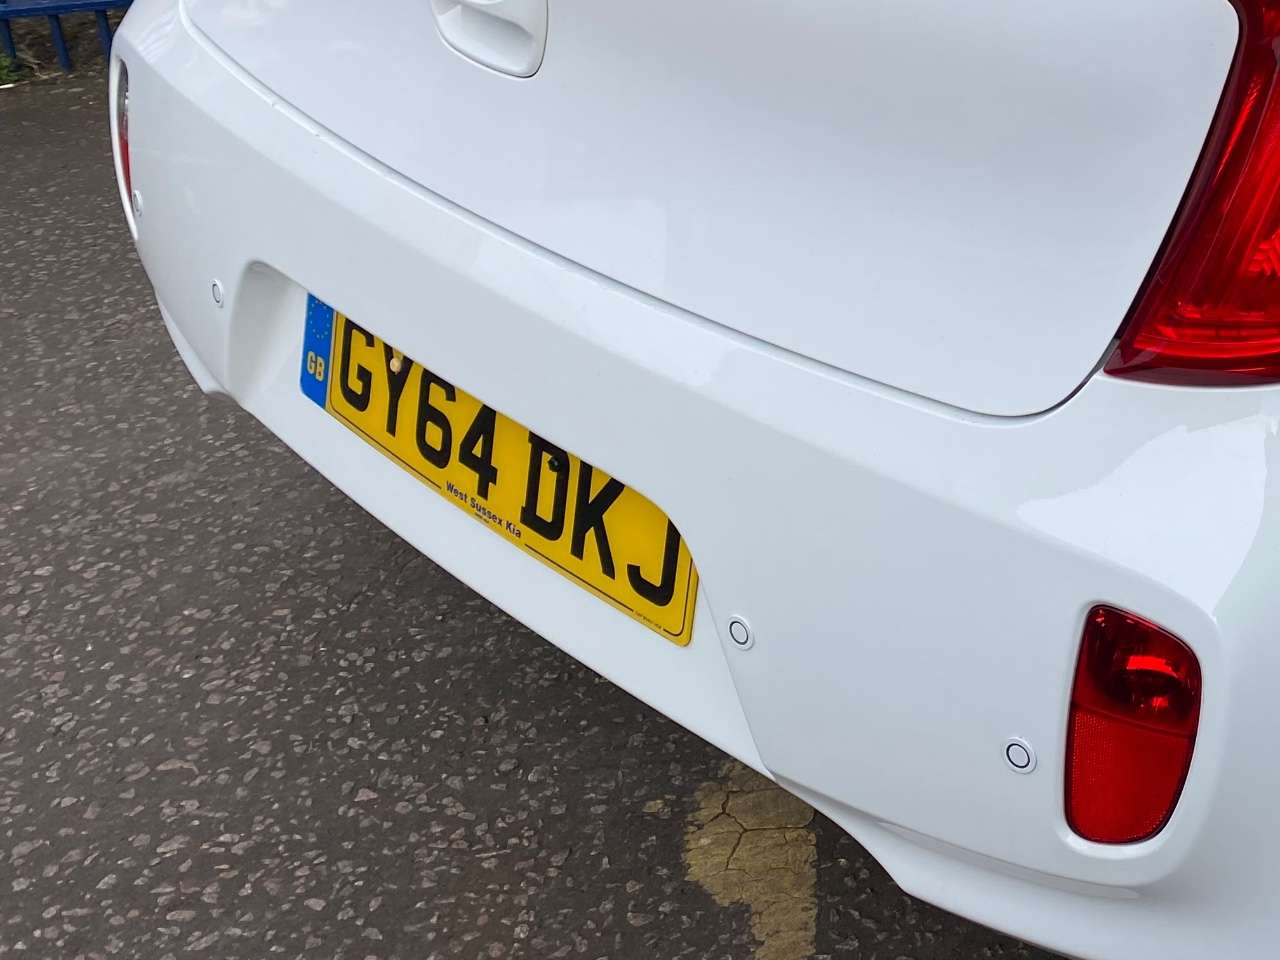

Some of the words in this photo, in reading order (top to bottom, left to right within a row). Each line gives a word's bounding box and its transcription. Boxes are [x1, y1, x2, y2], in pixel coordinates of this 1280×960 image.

[307, 350, 326, 383] GB
[340, 317, 498, 501] GY64
[520, 430, 682, 608] DKJ
[446, 480, 468, 503] West
[470, 497, 503, 528] Sussex
[505, 520, 522, 538] Kia
